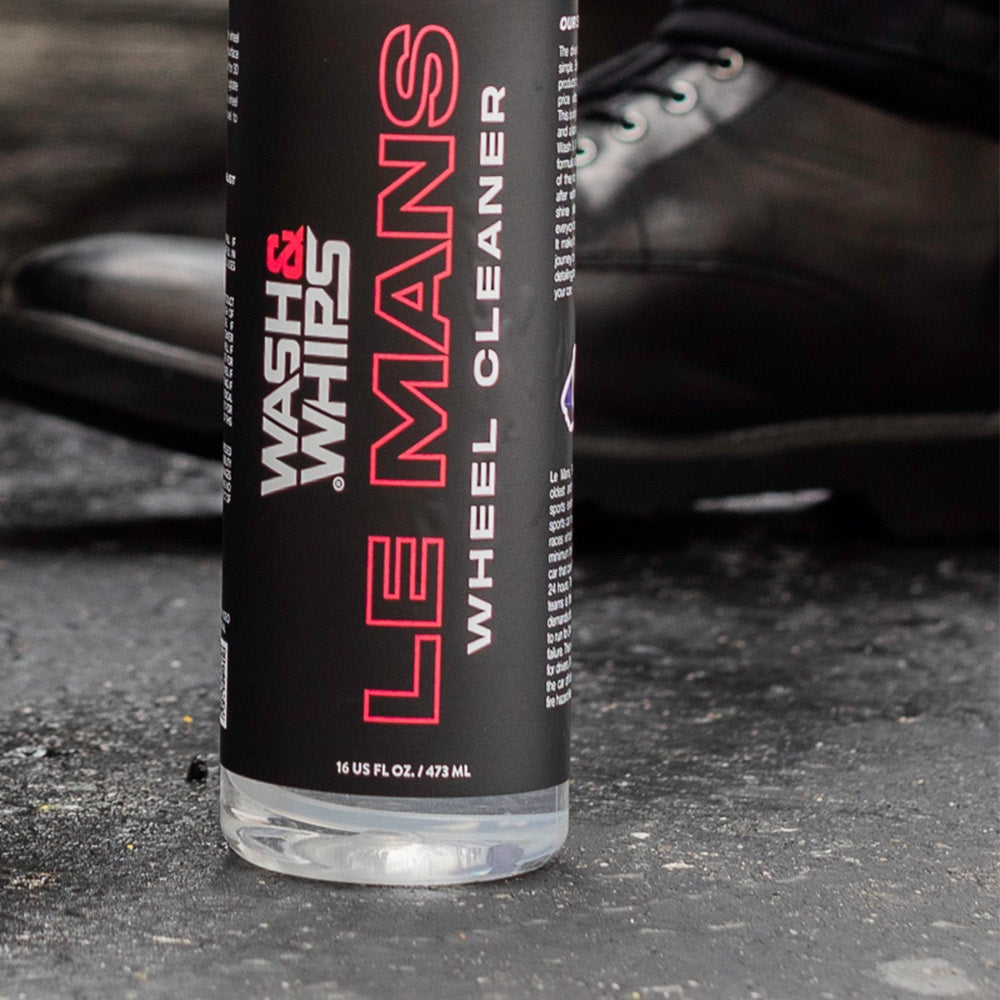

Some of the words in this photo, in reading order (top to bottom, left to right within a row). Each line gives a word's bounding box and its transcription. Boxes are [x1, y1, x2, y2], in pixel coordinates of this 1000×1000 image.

[300, 225, 351, 486] WHIPS
[369, 23, 460, 488] MANS
[473, 85, 507, 388] CLEANER
[363, 534, 444, 725] LE
[466, 418, 498, 656] WHEEL
[335, 760, 350, 776] 16
[352, 761, 371, 777] US
[373, 762, 390, 778] FL
[391, 763, 415, 778] OZ.
[417, 764, 424, 778] /
[425, 764, 449, 778] 473
[451, 764, 472, 779] ML
